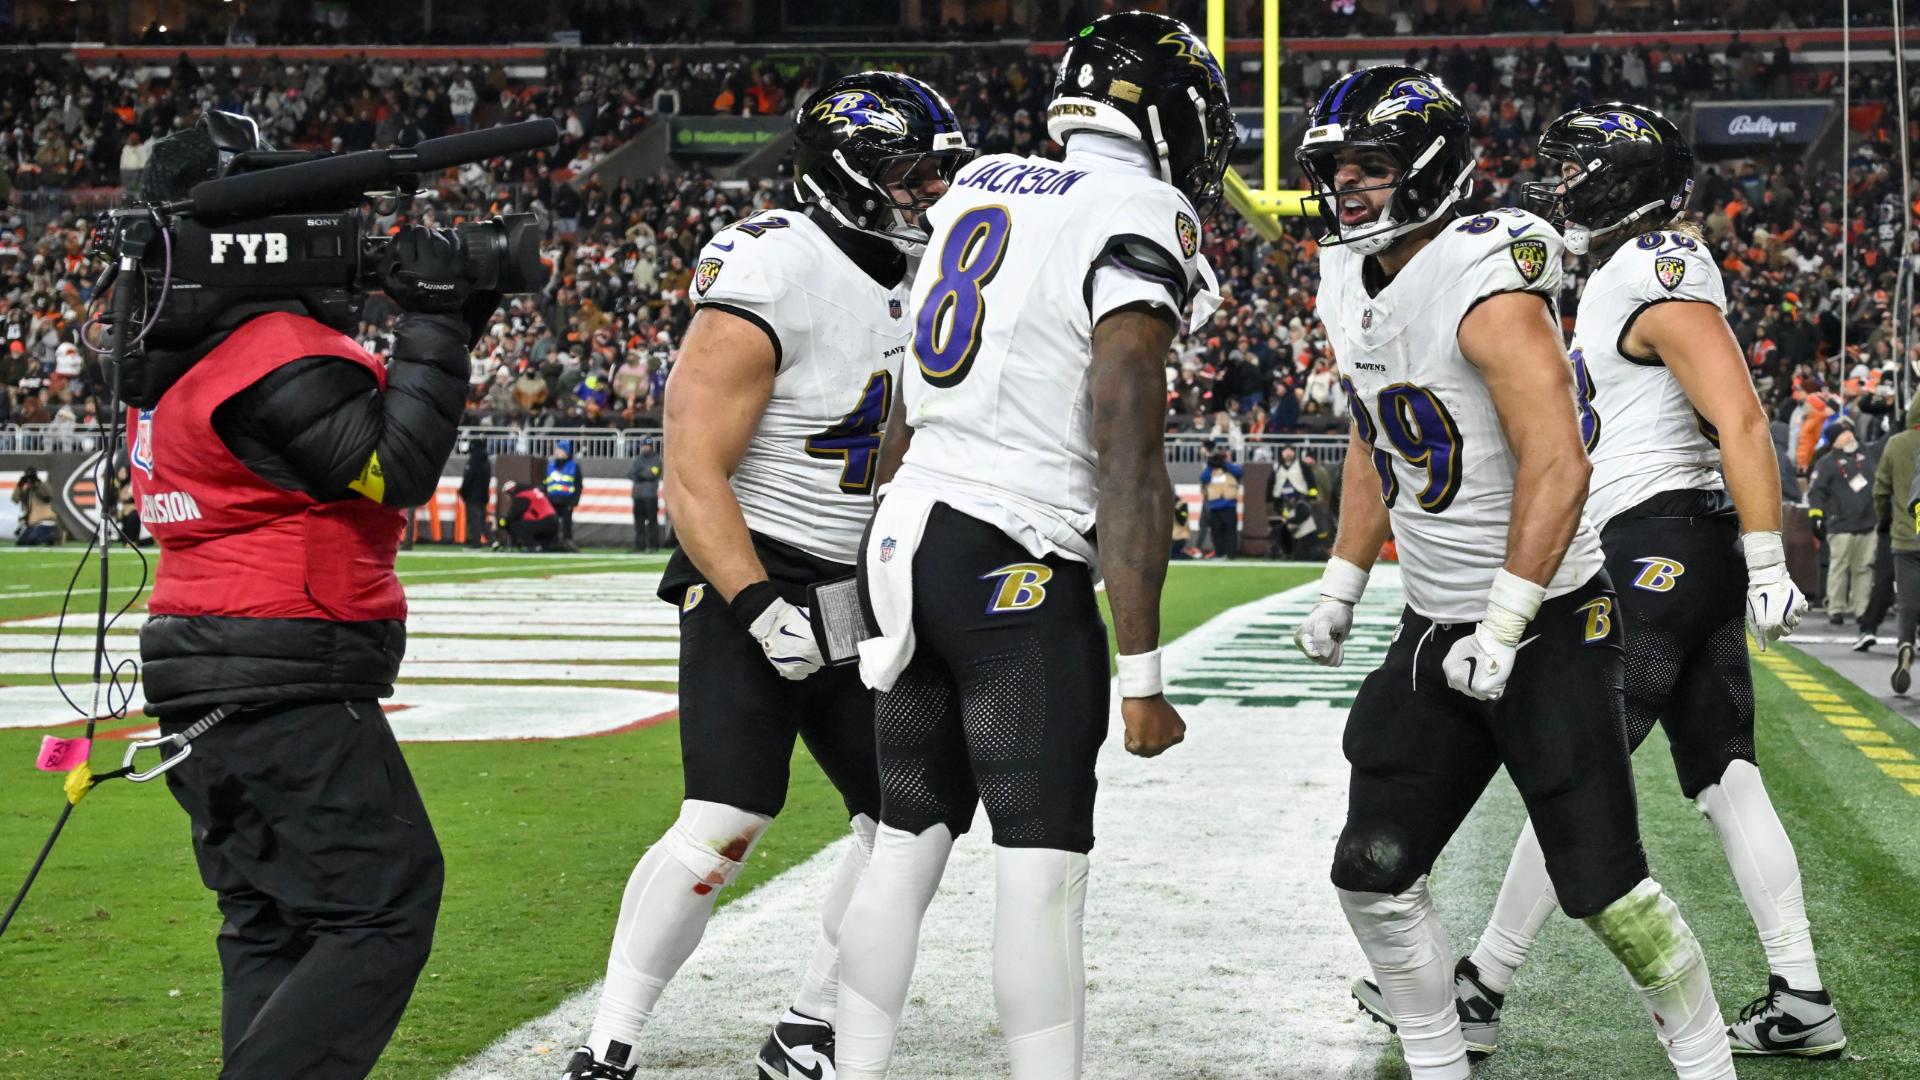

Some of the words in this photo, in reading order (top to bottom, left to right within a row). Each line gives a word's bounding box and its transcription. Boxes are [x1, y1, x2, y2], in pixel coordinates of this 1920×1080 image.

[1078, 64, 1094, 88] 8
[1048, 104, 1096, 117] AVENS
[1728, 115, 1778, 138] Bally
[957, 160, 1089, 195] JACKSON
[307, 218, 339, 227] SONY
[210, 232, 288, 264] FYB
[1513, 241, 1544, 250] RAVENS
[417, 281, 456, 290] FUJINON
[911, 203, 1012, 389] 8
[883, 345, 907, 359] RAVE
[1354, 361, 1387, 372] RAVENS
[804, 369, 893, 495] 4
[1632, 556, 1685, 592] B
[977, 562, 1053, 615] B
[1575, 597, 1612, 646] B
